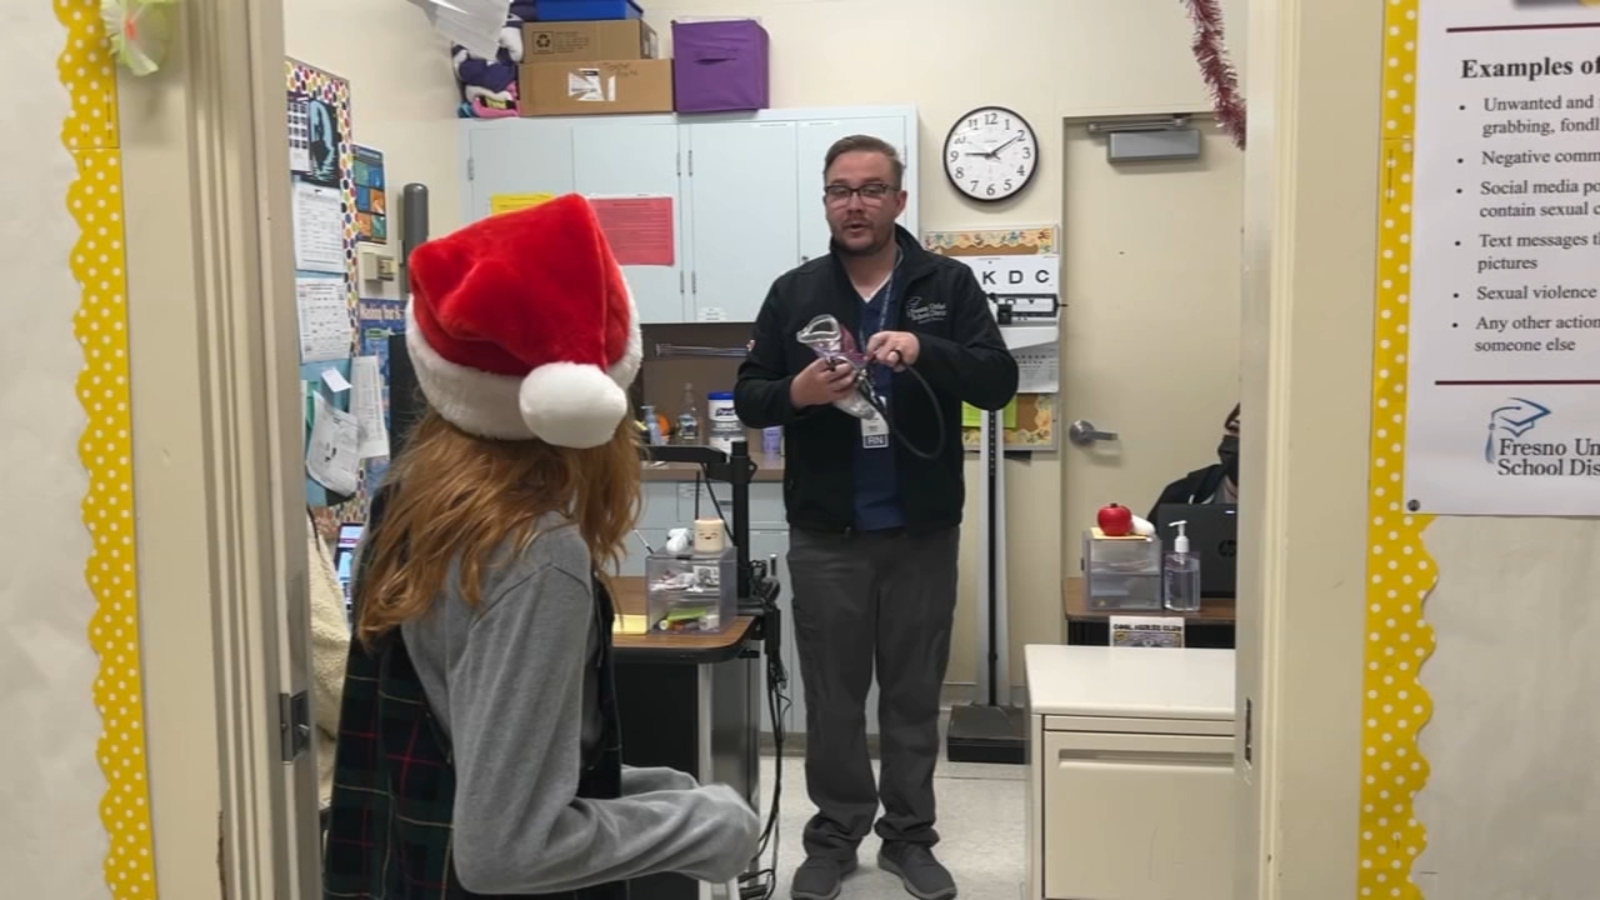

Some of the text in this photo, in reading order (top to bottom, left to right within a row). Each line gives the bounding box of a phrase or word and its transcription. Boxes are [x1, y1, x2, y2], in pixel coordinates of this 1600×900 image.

[1461, 57, 1573, 81] Examples
[1484, 94, 1594, 112] Unwanted and
[968, 119, 979, 130] 11
[985, 113, 998, 125] 12
[1005, 119, 1010, 130] 1
[1482, 117, 1600, 138] grabbing, fondl
[1017, 130, 1026, 141] 2
[950, 150, 959, 163] 9
[1023, 147, 1031, 159] 3
[1481, 150, 1600, 167] Negative comm
[955, 167, 964, 179] 8
[1016, 165, 1025, 176] 4
[970, 180, 979, 192] 7
[986, 184, 995, 196] 6
[1004, 179, 1012, 191] 5
[1480, 180, 1528, 196] Social
[1533, 179, 1579, 193] media
[1479, 203, 1535, 217] contain
[1540, 201, 1588, 216] sexual
[1479, 234, 1512, 248] Text
[1516, 235, 1588, 250] messages
[1477, 256, 1538, 273] pictures
[982, 269, 1050, 285] K D C
[1477, 285, 1597, 300] Sexual violence
[1476, 315, 1600, 333] Any other action
[1475, 337, 1576, 351] someone else
[868, 436, 884, 445] RN
[1498, 438, 1600, 456] Fresno Un
[1498, 458, 1600, 477] School Dis
